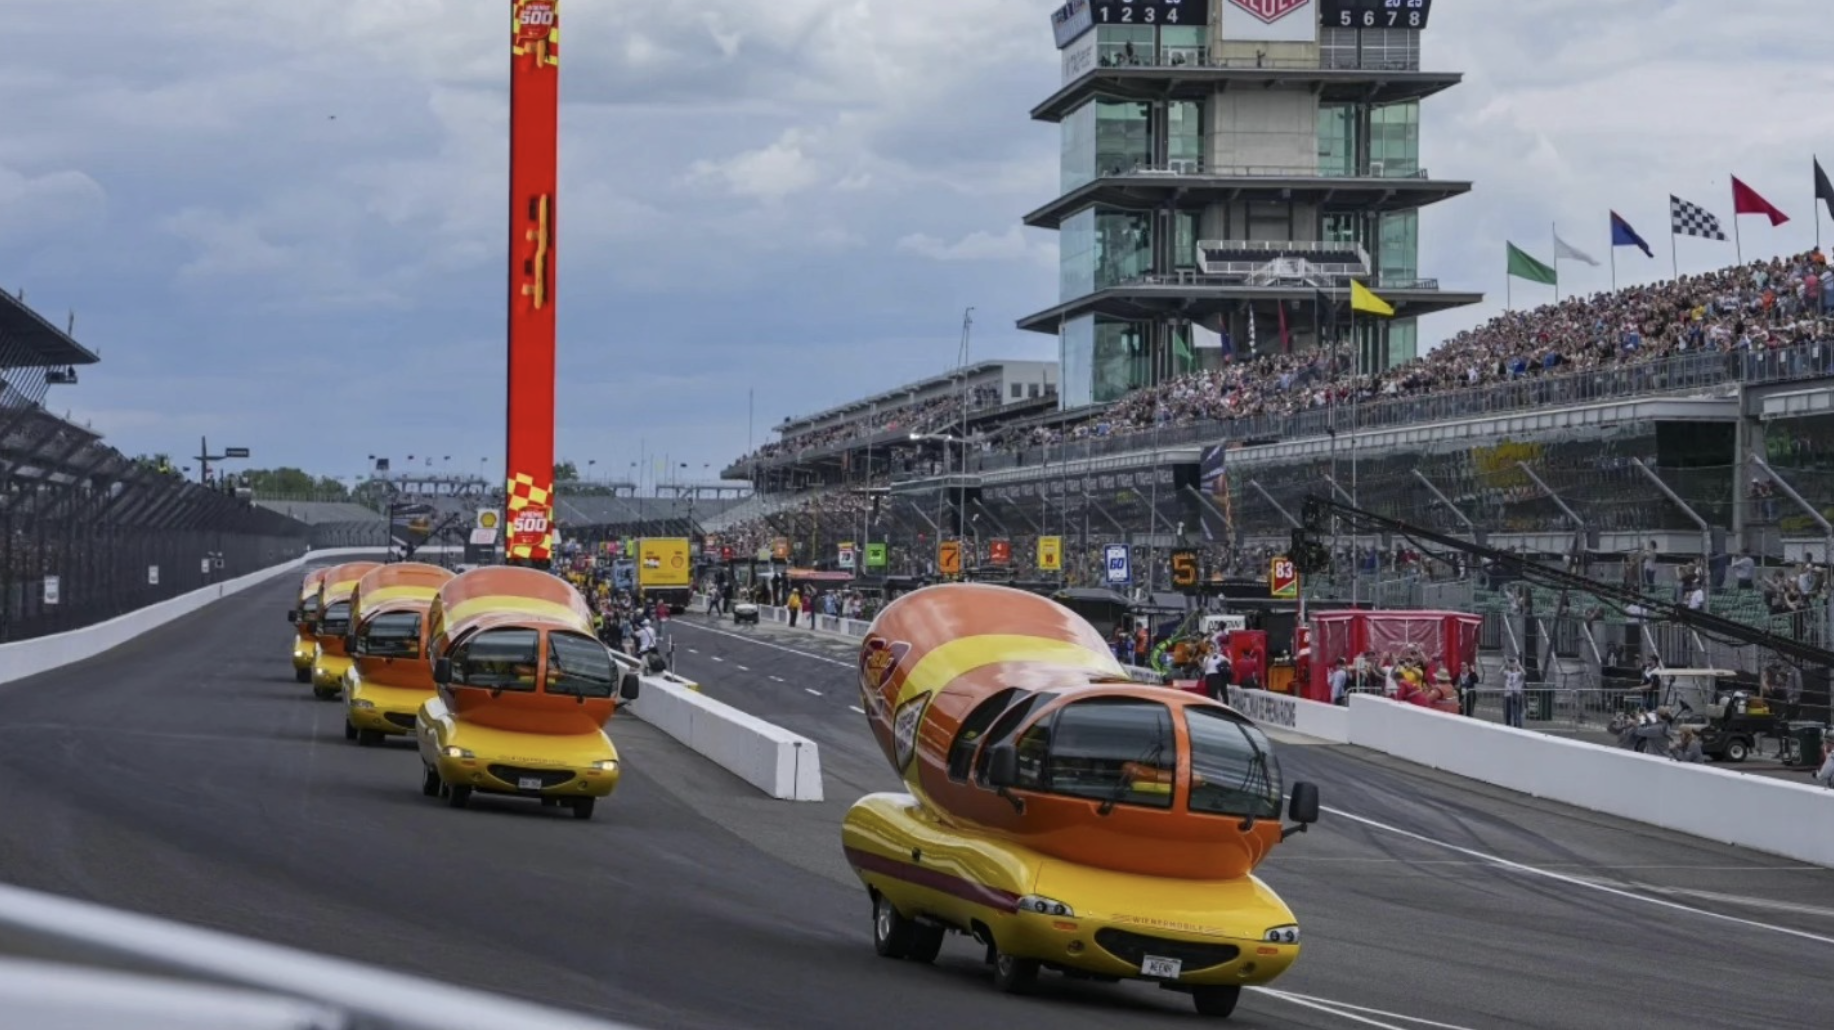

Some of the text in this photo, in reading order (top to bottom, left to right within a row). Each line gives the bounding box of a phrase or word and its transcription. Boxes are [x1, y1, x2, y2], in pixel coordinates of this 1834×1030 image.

[519, 11, 554, 25] 500
[1100, 6, 1178, 23] 1 2 3 4
[1341, 10, 1420, 26] 5 6 7 8
[513, 518, 548, 532] 500
[941, 545, 959, 568] 7
[1109, 557, 1125, 570] 60
[1172, 552, 1196, 585] 5
[1275, 560, 1294, 579] 83
